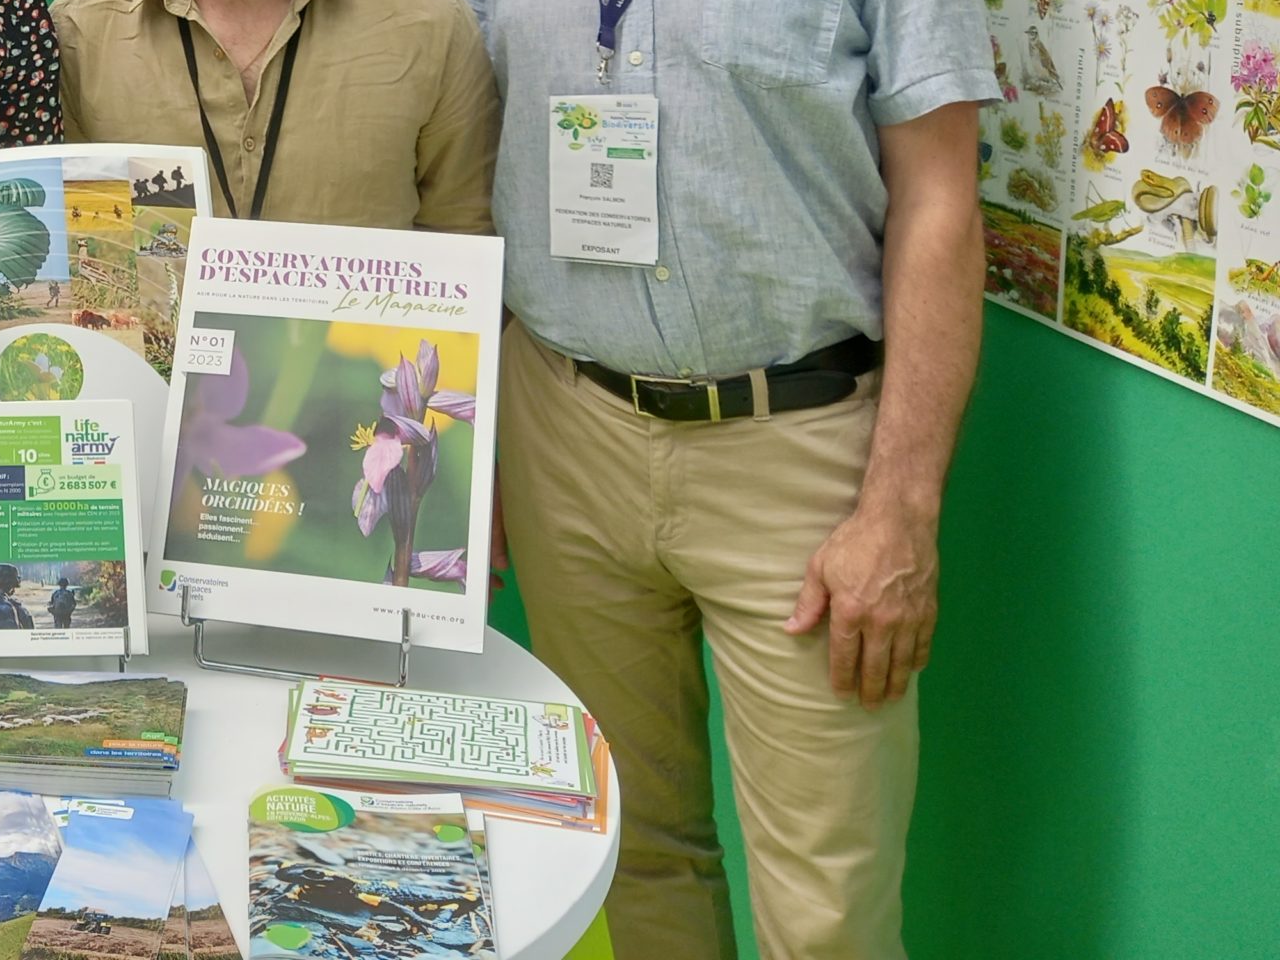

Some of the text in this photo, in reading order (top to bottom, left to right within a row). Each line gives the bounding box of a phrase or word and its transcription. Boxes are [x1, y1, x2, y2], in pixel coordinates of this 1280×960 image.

[1232, 13, 1243, 75] subalpins
[601, 119, 656, 130] Biodiversité
[581, 244, 621, 255] EXPOSANT
[200, 247, 424, 279] CONSERVATOIRES
[199, 264, 469, 300] D'ESPACES NATURELS
[291, 297, 329, 305] TERRITOIRES
[332, 288, 468, 317] Le Magazine
[190, 335, 225, 348] N°01
[187, 353, 223, 367] 2023
[74, 419, 100, 432] life
[65, 432, 109, 443] natur
[71, 436, 120, 456] army
[18, 449, 37, 463] 10
[110, 480, 117, 489] €
[203, 477, 290, 498] MAGIQUES
[201, 494, 305, 516] ORCHIDÉES !
[200, 513, 218, 522] Elles
[179, 574, 229, 587] Conservatoires
[267, 802, 316, 814] NATURE
[358, 856, 397, 865] EXPOSITIONS
